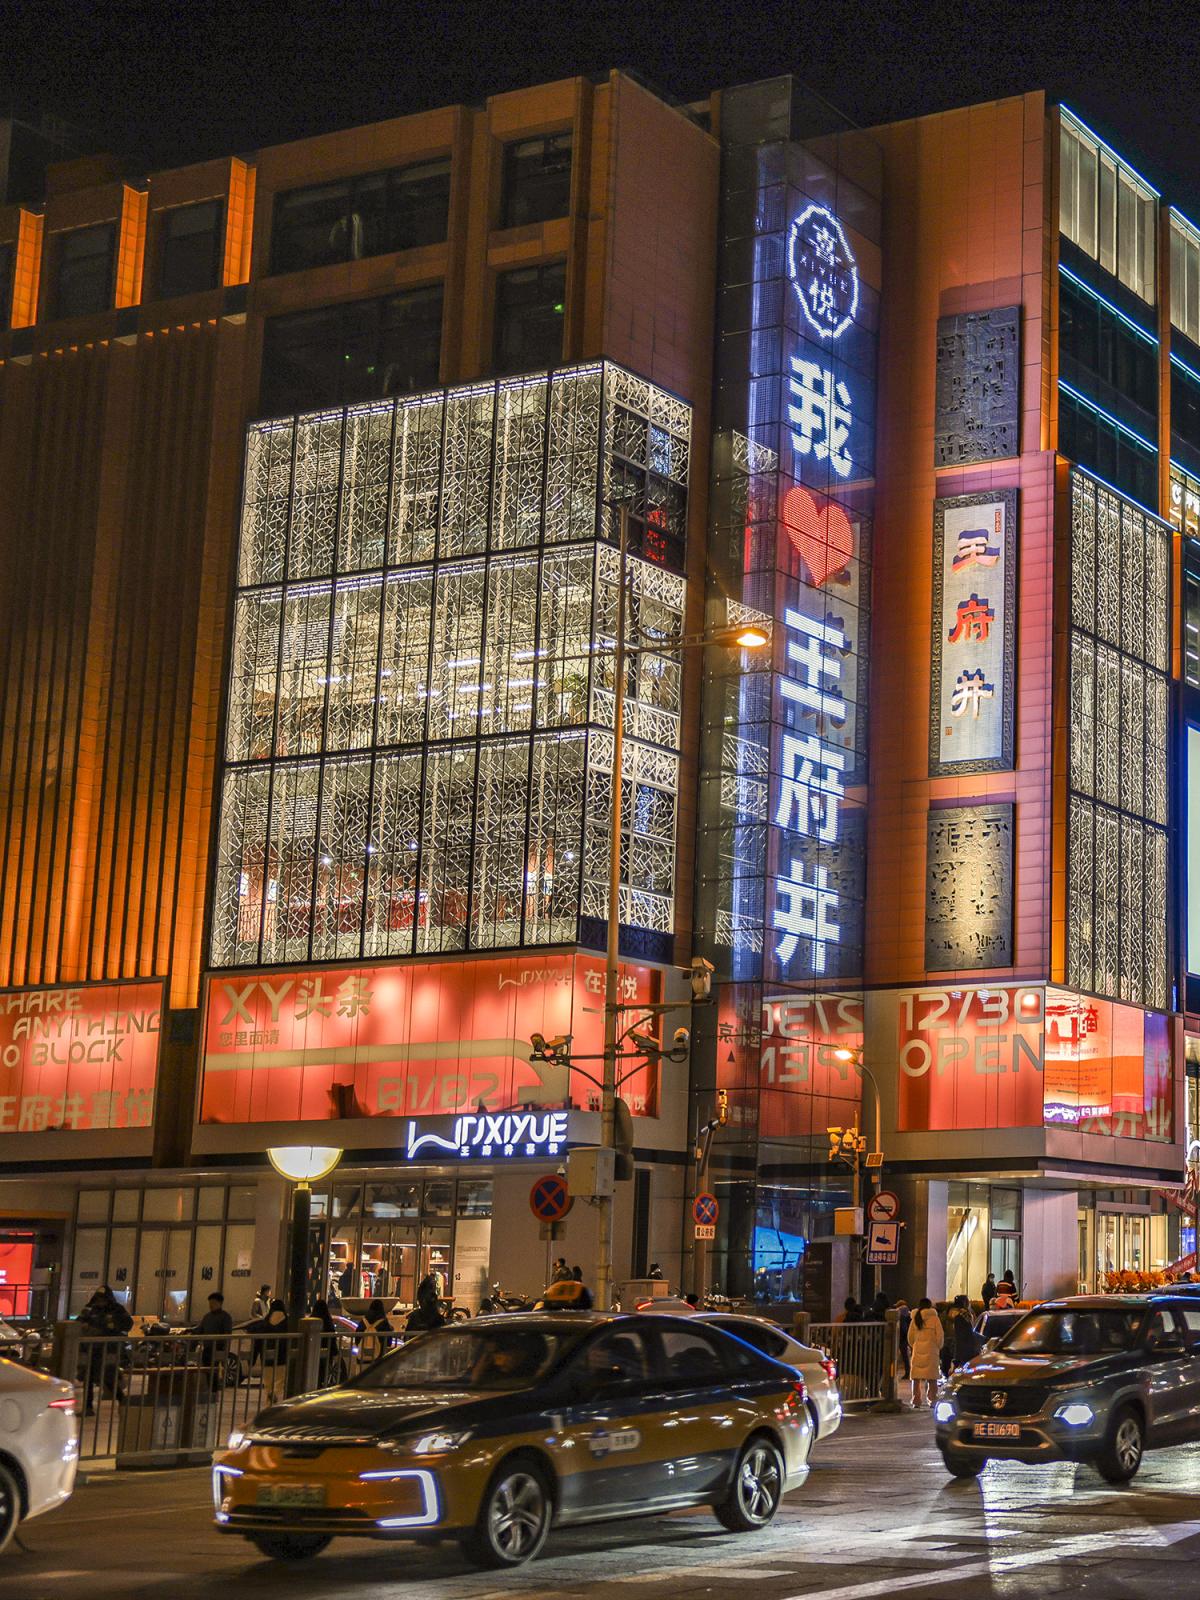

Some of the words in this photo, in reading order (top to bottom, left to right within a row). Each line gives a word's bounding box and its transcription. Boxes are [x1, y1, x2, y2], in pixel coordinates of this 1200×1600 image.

[787, 355, 852, 478] 我
[948, 529, 1000, 719] 王府井
[773, 607, 848, 973] 王府井
[0, 988, 83, 1015] HARE
[220, 975, 374, 1025] XY头条
[584, 968, 638, 1000] 在悦
[12, 1010, 161, 1041] ANYTHING
[899, 987, 1045, 1031] 12/30
[31, 1038, 125, 1066] BLOCK
[218, 1029, 280, 1048] 您里面请
[900, 1032, 1044, 1077] OPEN
[377, 1072, 501, 1110] B1/B2
